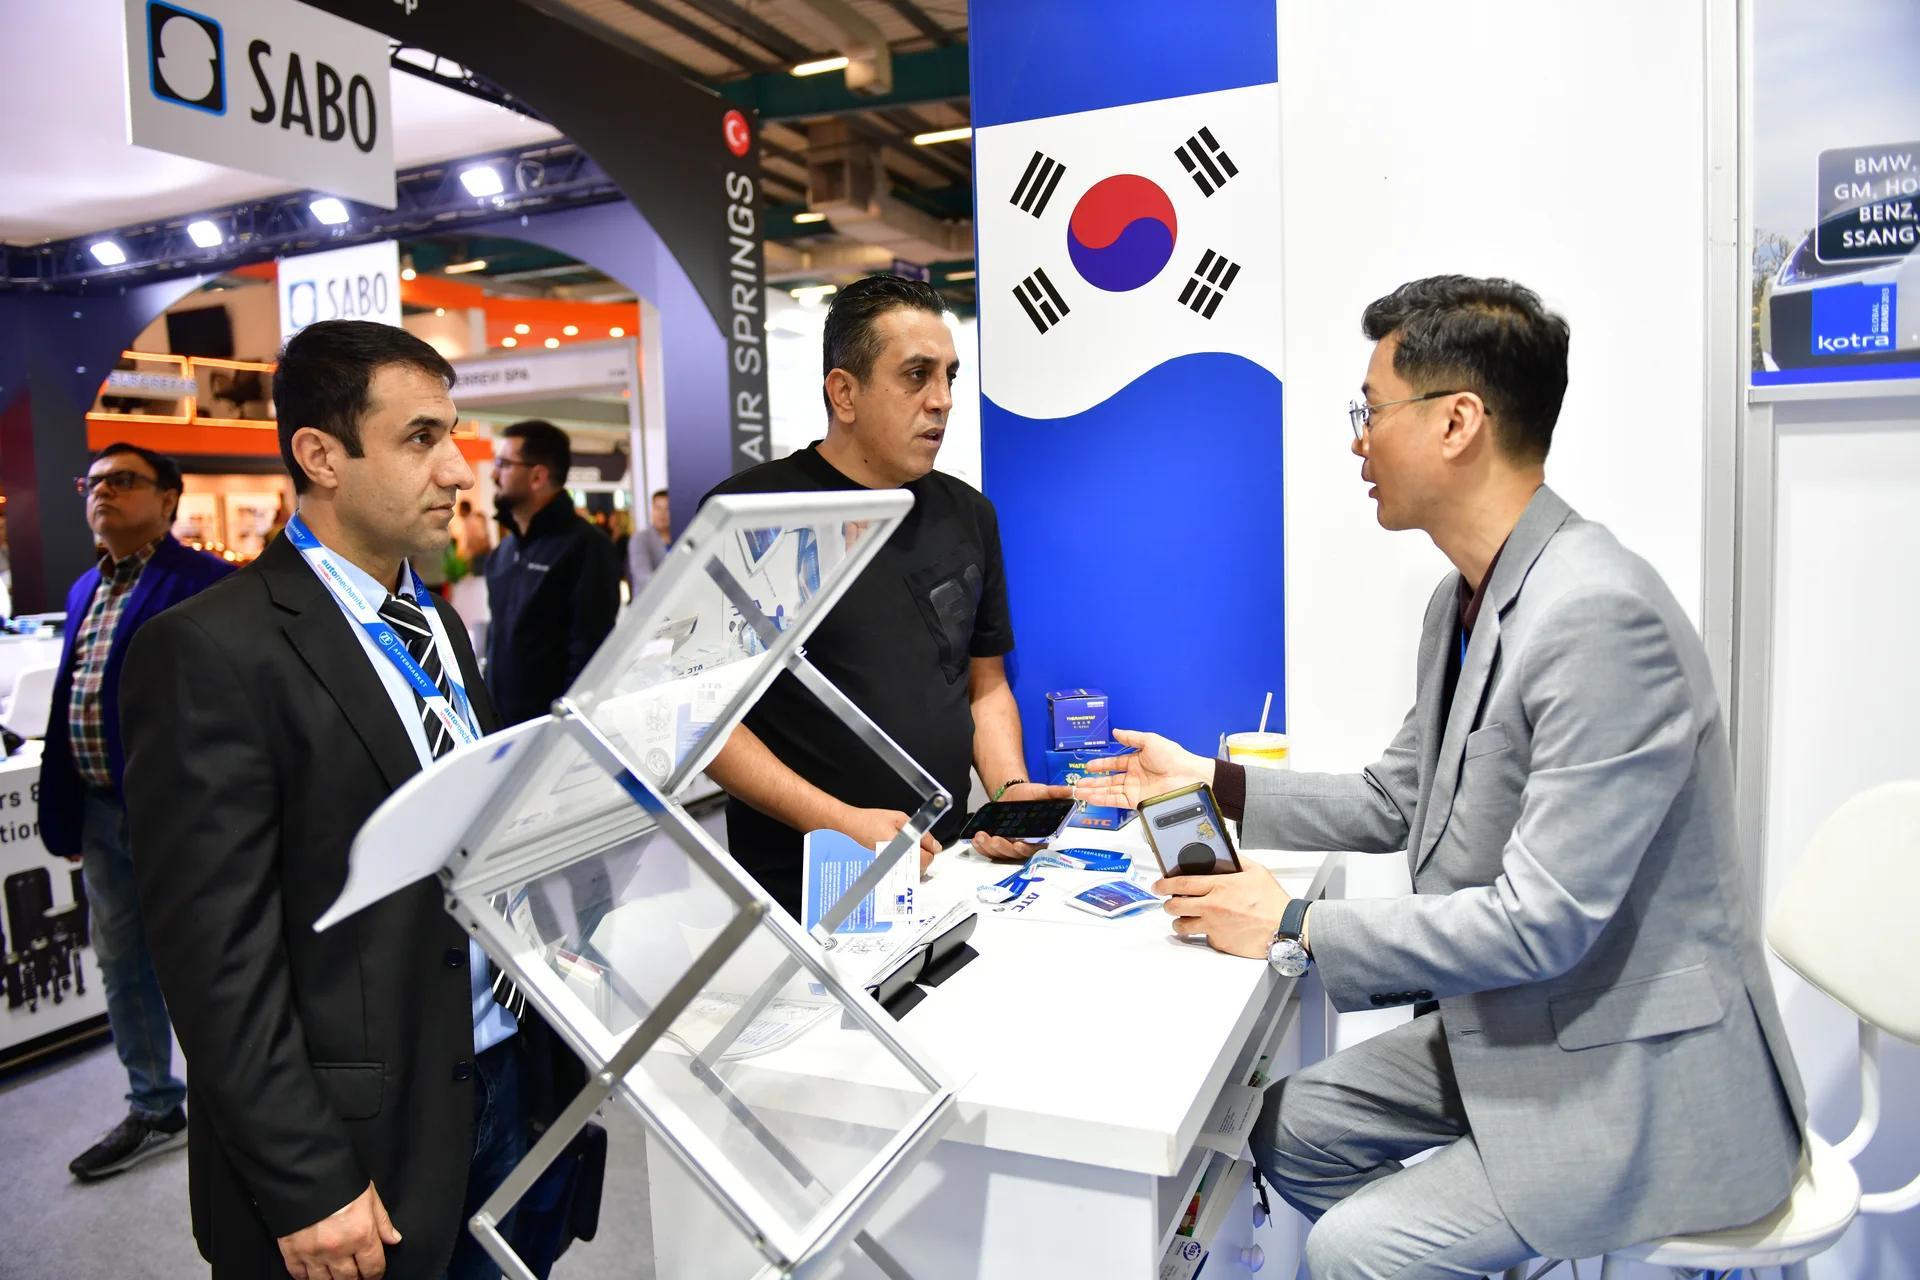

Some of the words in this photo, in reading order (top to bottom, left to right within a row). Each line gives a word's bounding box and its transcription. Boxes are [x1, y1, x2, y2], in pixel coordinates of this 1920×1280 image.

[248, 39, 377, 153] SABO
[1855, 154, 1917, 174] BMW,
[1834, 182, 1877, 200] GM,
[1885, 177, 1920, 196] HO
[1859, 202, 1918, 223] BENZ,
[1842, 225, 1920, 248] SSANG
[726, 171, 762, 375] SPRINGS
[327, 271, 388, 320] SABO
[1818, 333, 1889, 351] kotra
[736, 391, 765, 463] AIR
[321, 559, 366, 611] automechanika
[393, 648, 428, 688] AFTERMARKET
